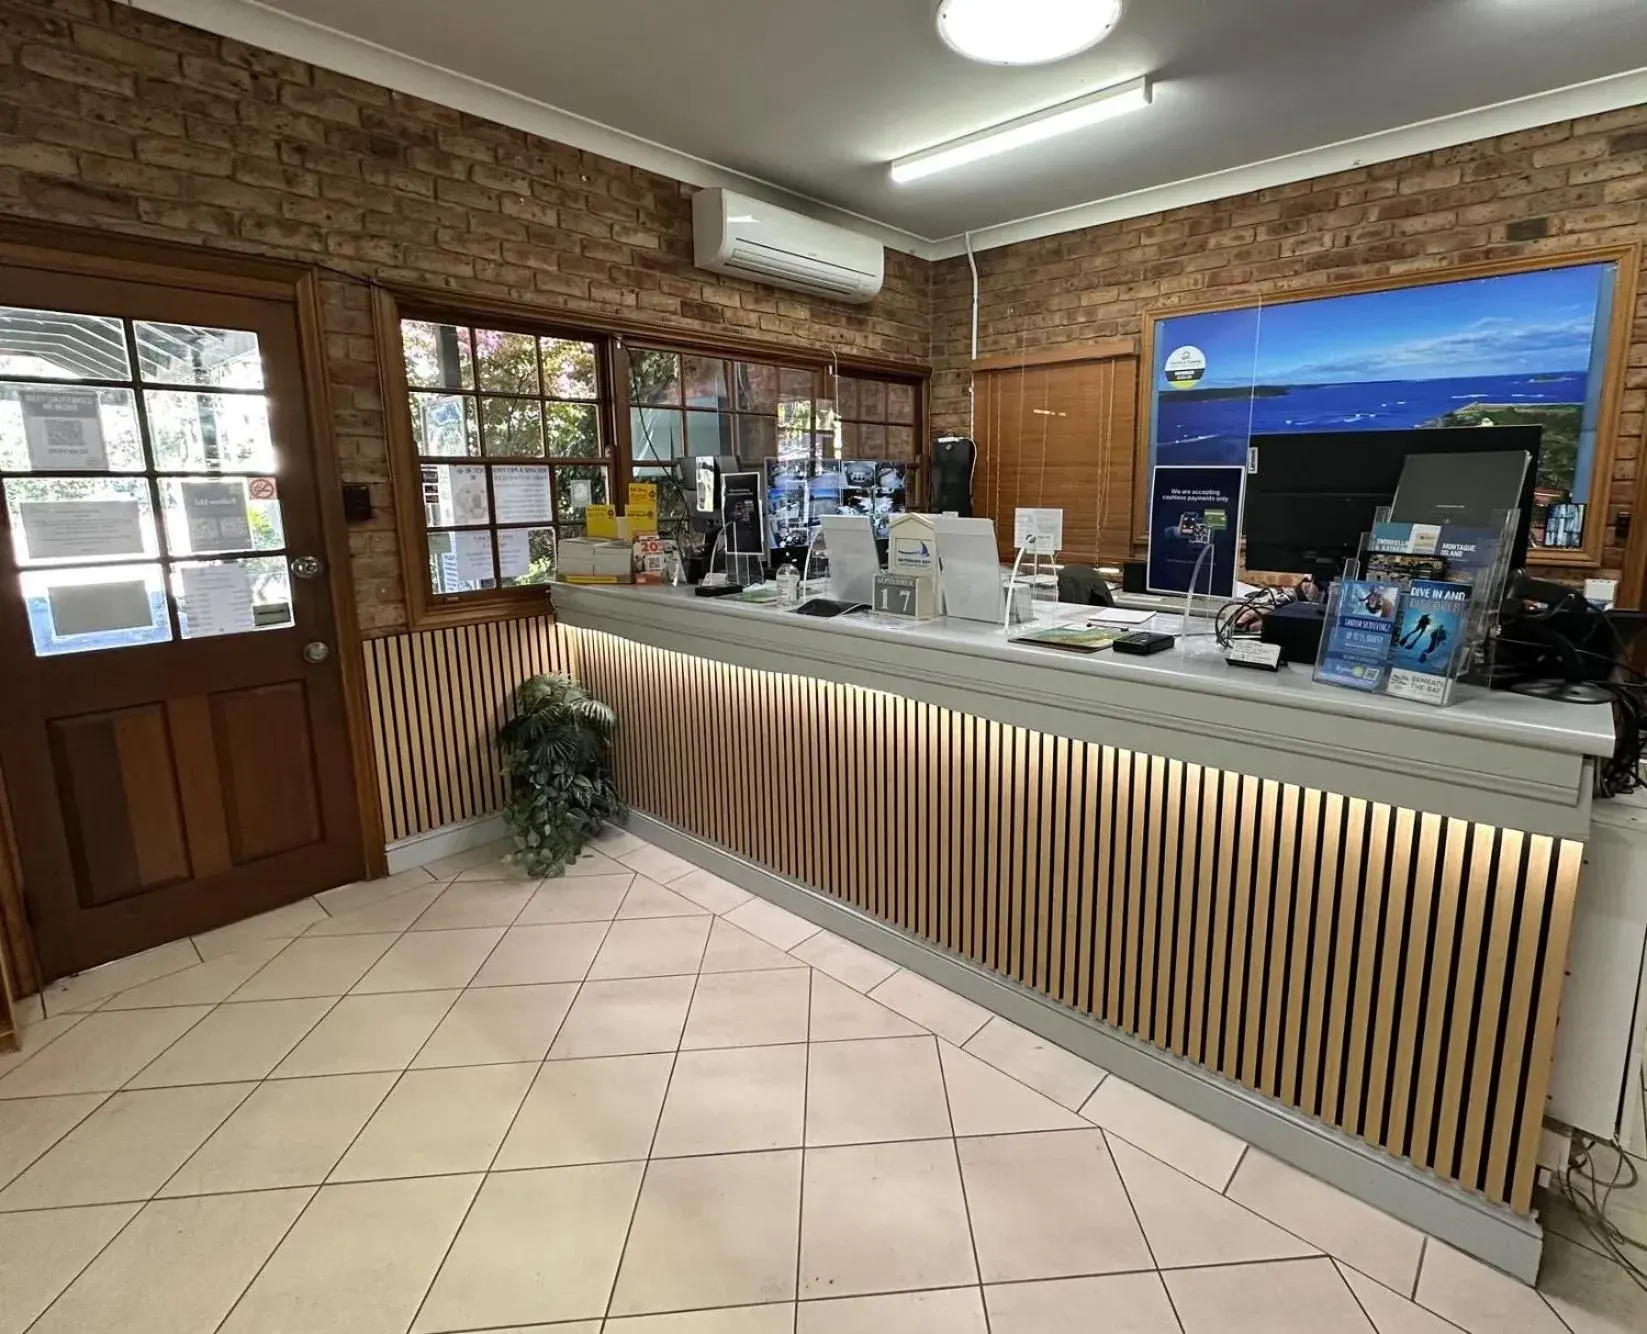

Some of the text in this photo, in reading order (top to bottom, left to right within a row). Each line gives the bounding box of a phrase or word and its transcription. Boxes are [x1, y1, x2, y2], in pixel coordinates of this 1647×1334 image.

[1192, 489, 1220, 497] accepting
[1442, 542, 1477, 552] MONTAGUE
[1440, 549, 1464, 557] ISLAND
[1411, 586, 1466, 602] DIVE IN AND
